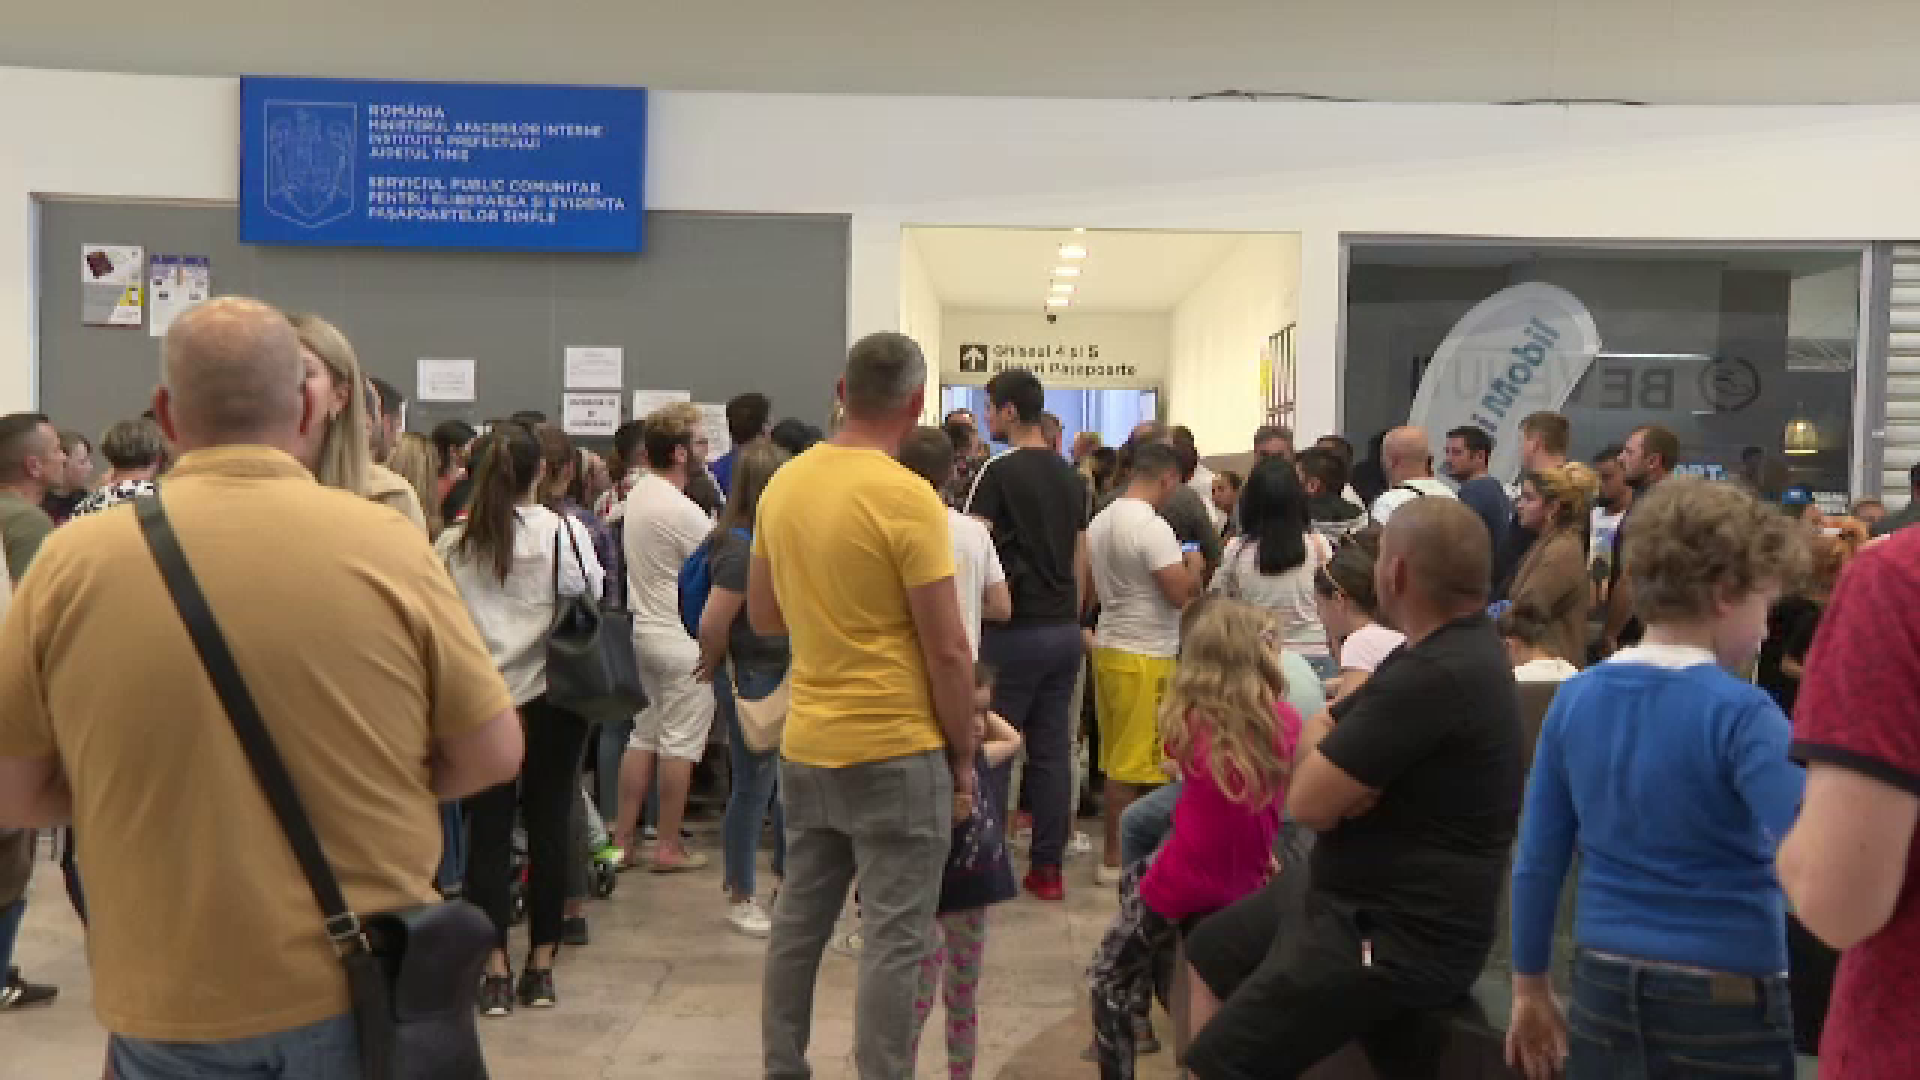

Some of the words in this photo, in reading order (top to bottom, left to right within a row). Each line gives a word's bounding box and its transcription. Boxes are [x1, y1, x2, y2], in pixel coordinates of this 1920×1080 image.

[450, 177, 505, 192] PUBLIC
[368, 191, 427, 206] PENTRU
[503, 209, 557, 224] SIMPLE
[1482, 316, 1561, 418] Mobil
